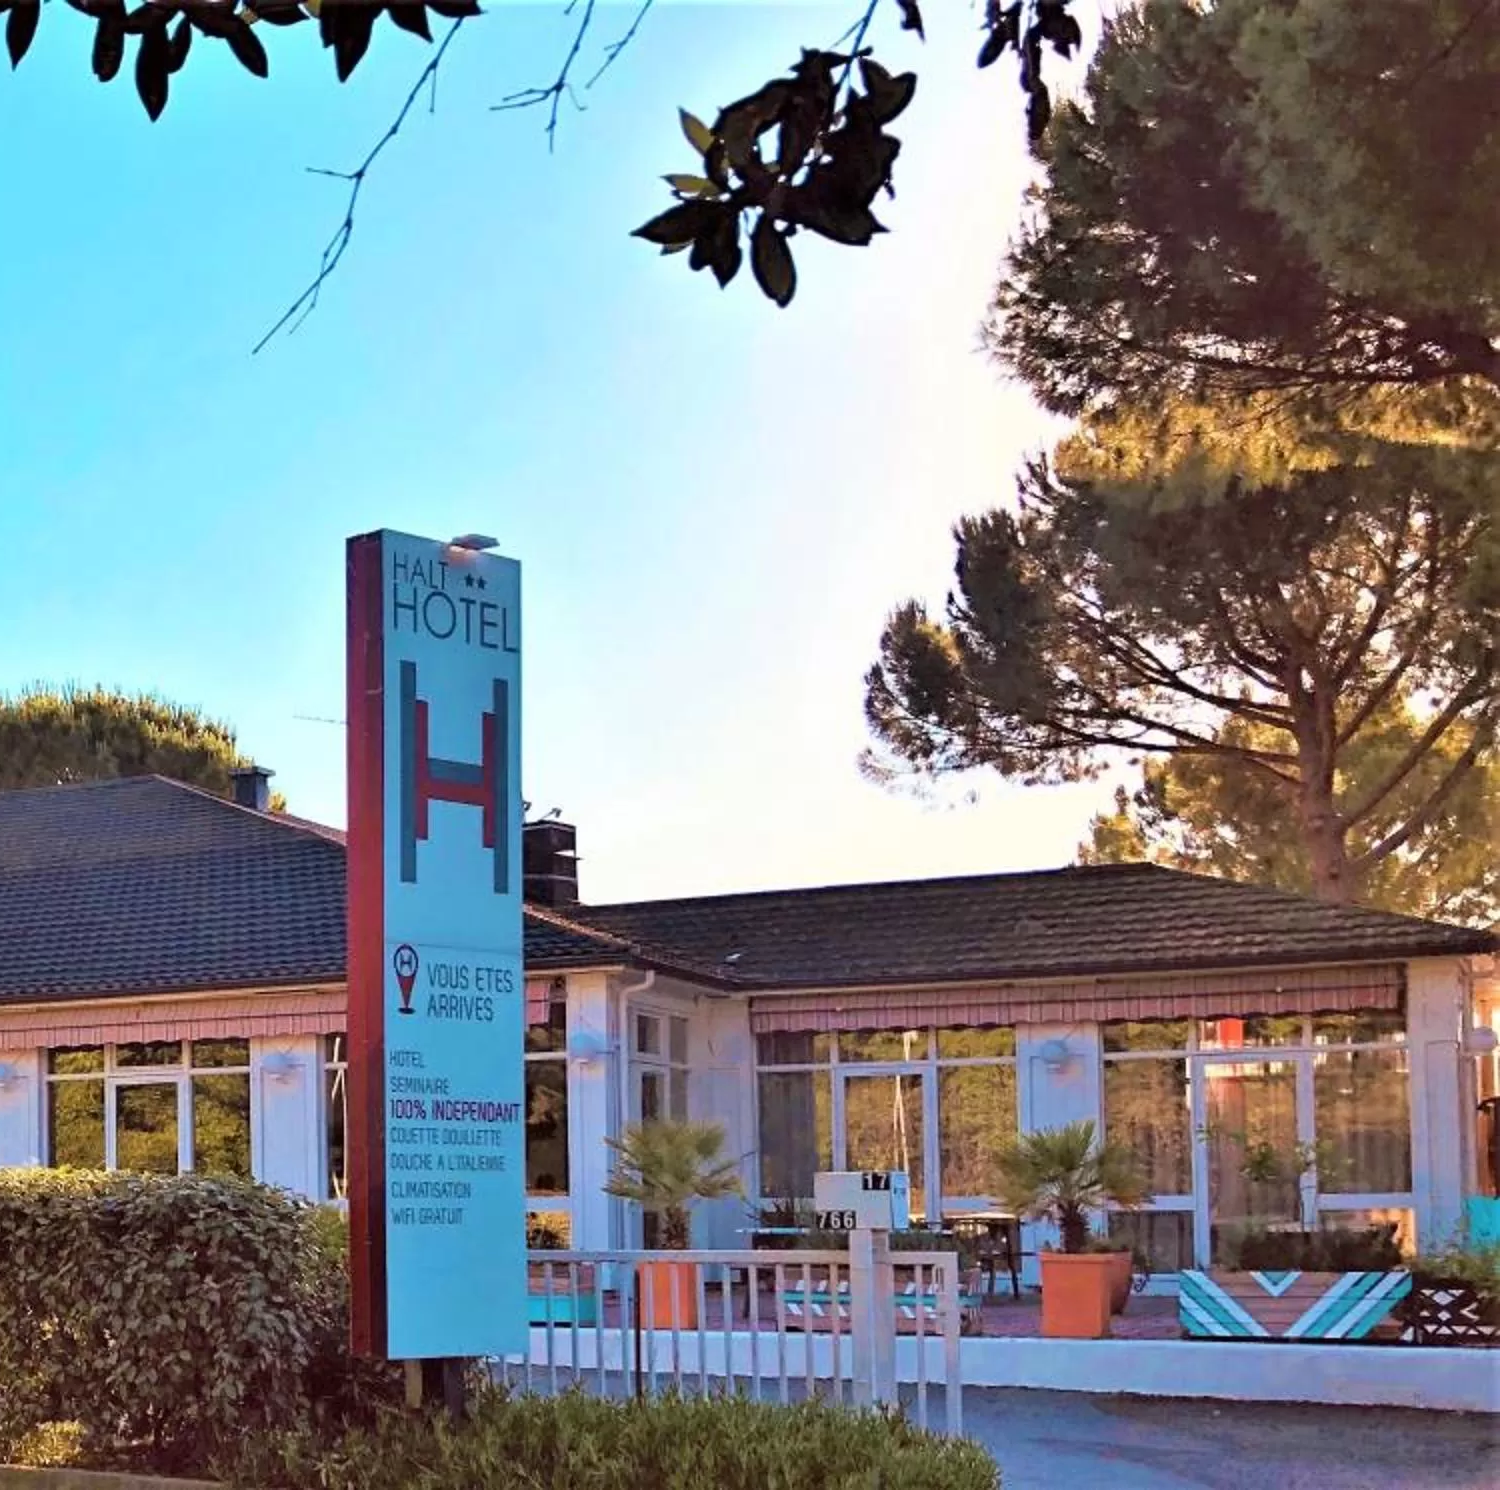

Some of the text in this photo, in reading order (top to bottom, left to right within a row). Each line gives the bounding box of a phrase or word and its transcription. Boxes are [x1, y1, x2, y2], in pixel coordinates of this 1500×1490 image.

[393, 551, 449, 590] HALT
[393, 582, 520, 654] HOTEL
[427, 963, 514, 993] VOUS ETES
[427, 993, 494, 1022] ARRIVES
[389, 1050, 426, 1069] HOTEL
[390, 1076, 450, 1095] SEMINAIRE
[390, 1099, 521, 1124] 100% INDEPENDANT
[390, 1126, 439, 1146] COUETTE
[390, 1152, 433, 1171] DOUCHE
[437, 1154, 445, 1170] A
[391, 1181, 471, 1199] CLIMATISATION
[864, 1173, 887, 1190] 17
[391, 1207, 463, 1225] WIFI GRATUIT
[817, 1210, 854, 1230] 766
